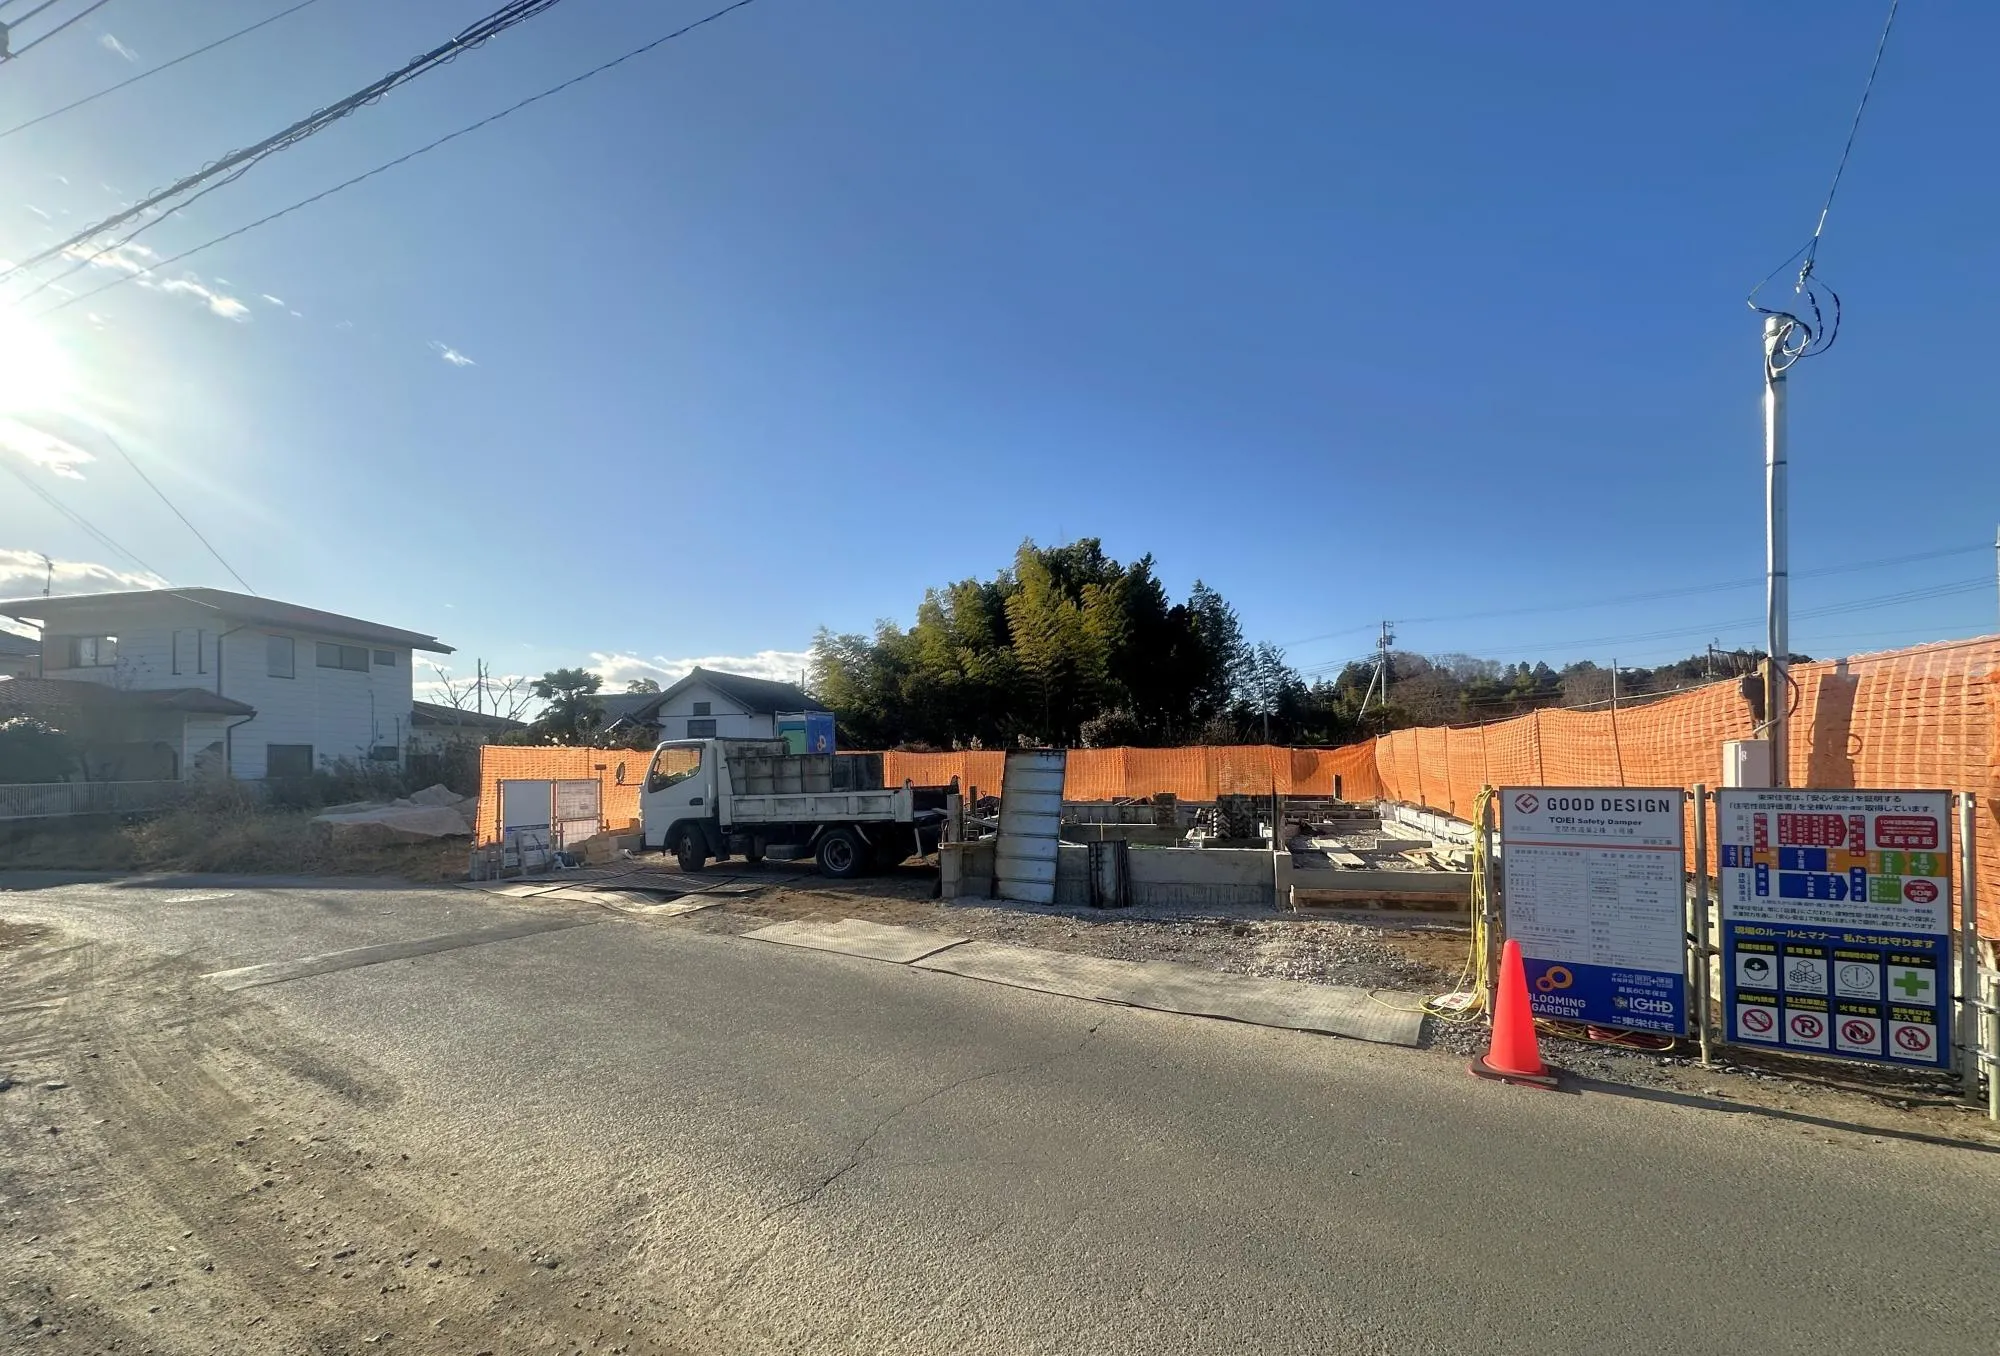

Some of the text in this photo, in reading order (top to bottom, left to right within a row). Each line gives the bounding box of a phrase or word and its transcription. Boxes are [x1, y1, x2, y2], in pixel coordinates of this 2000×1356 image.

[1547, 797, 1670, 813] GOOD DESIGN
[1577, 818, 1605, 826] Safety
[1608, 818, 1643, 827] Damper
[1733, 925, 1936, 949] 現場のルールとマナー 私たちは守ります
[1891, 955, 1931, 964] 安全第一
[1531, 1002, 1579, 1017] GARDEN
[1622, 1016, 1675, 1031] 東栄住宅
[1893, 1013, 1932, 1024] 立入禁止
